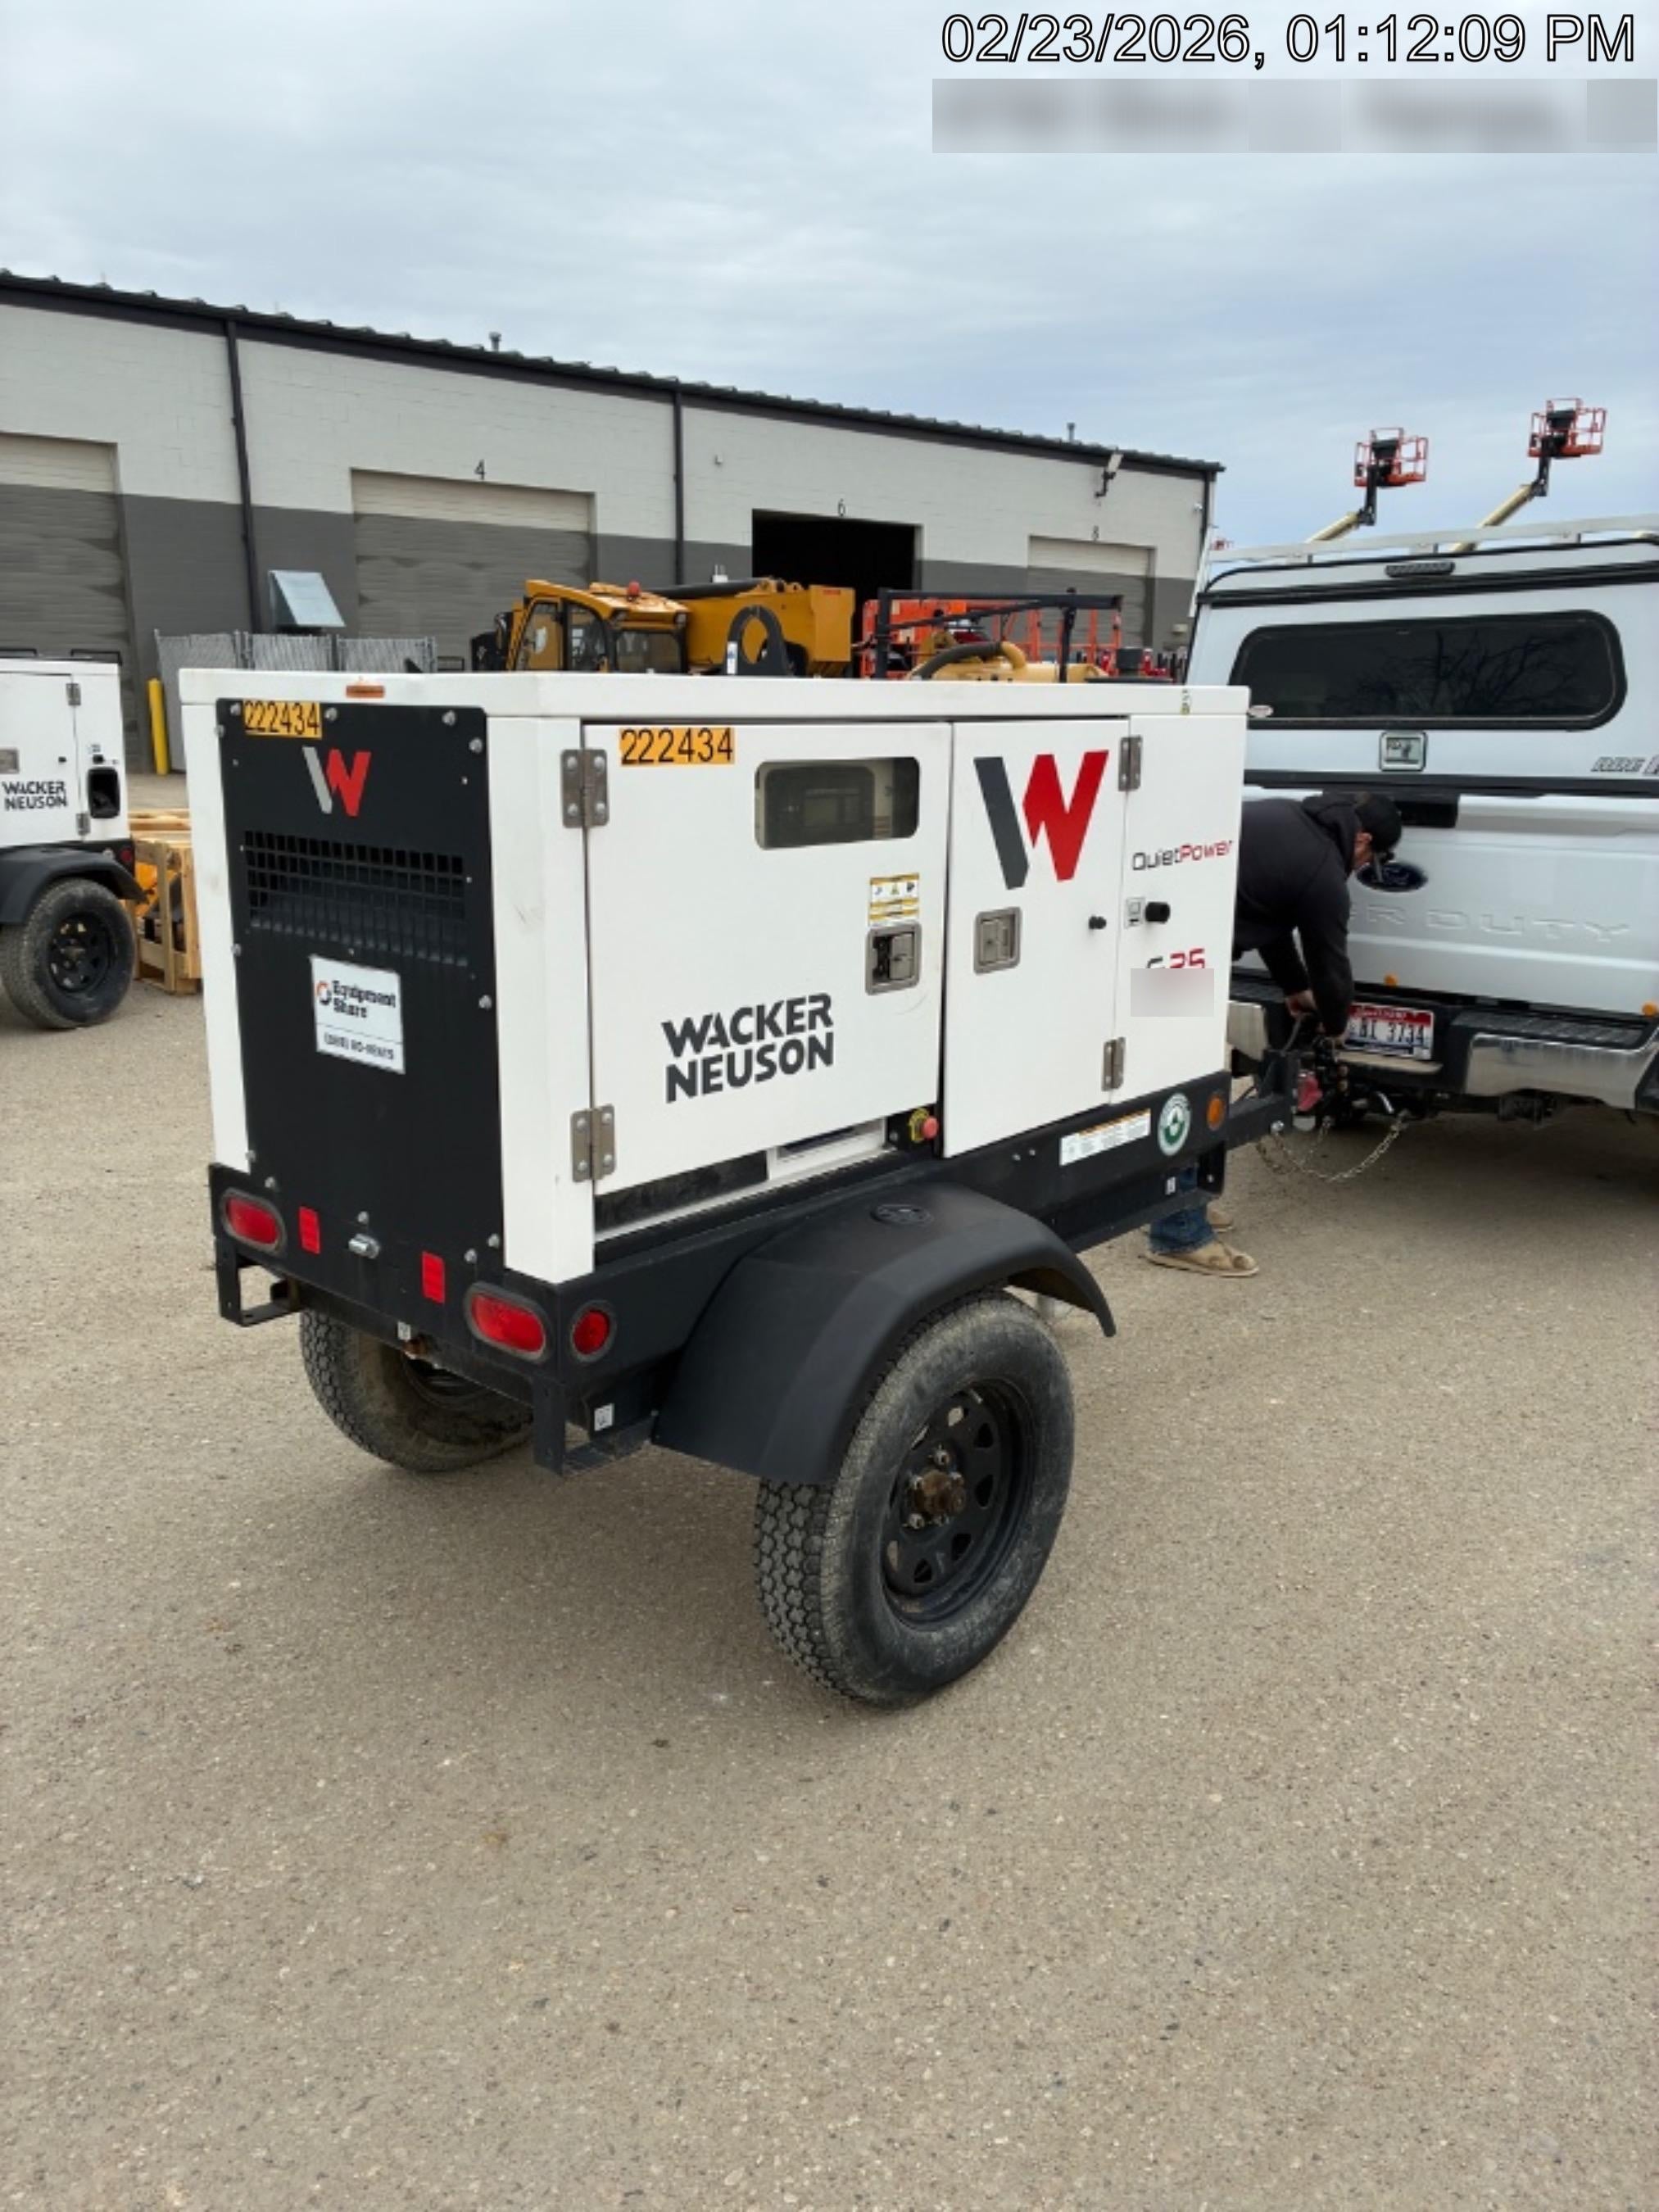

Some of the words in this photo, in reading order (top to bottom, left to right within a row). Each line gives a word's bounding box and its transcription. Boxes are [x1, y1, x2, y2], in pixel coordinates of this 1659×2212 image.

[474, 459, 485, 481] 4
[837, 498, 845, 518] 6
[245, 700, 319, 735] 222434
[621, 728, 732, 764] 222434
[2, 780, 66, 795] WACKER
[4, 796, 68, 811] NEUSON
[1132, 840, 1233, 871] QuietPower
[1426, 909, 1630, 942] DUTY
[661, 992, 834, 1058] WACKER
[665, 1031, 834, 1104] NEUSON
